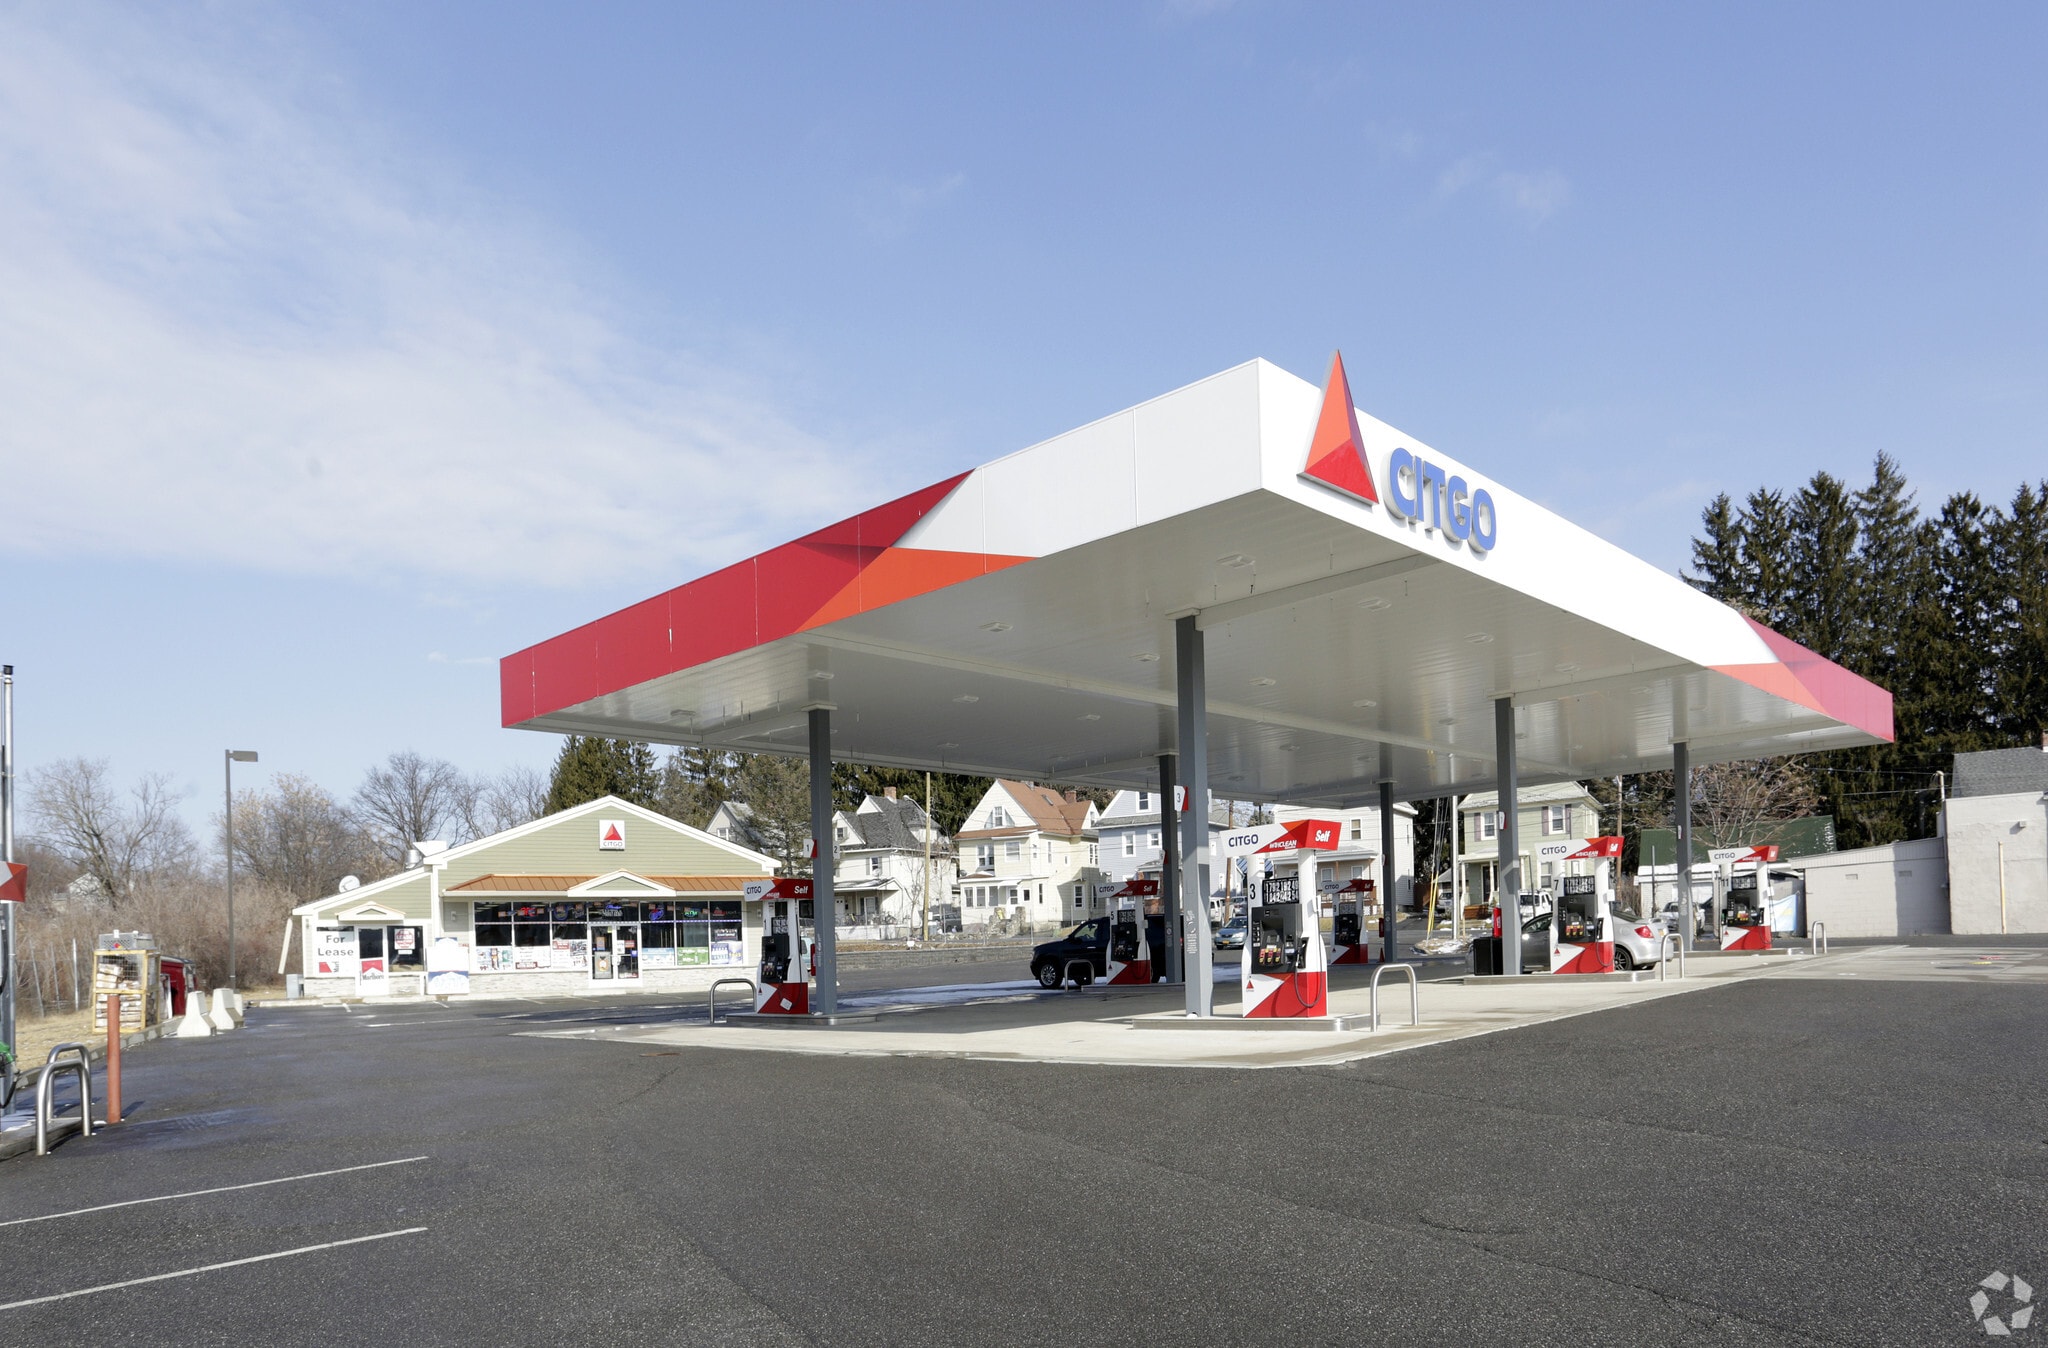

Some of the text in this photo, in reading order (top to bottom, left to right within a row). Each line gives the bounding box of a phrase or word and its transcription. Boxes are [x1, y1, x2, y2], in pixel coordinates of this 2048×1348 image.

[1389, 447, 1496, 551] CITGO
[1176, 792, 1180, 802] 3
[1228, 834, 1259, 847] CITGO
[1316, 830, 1330, 842] Self
[1542, 846, 1566, 855] CITGO
[746, 886, 762, 894] CITGO
[794, 885, 808, 894] Self
[1554, 880, 1559, 891] 7
[1250, 884, 1256, 900] 3
[1110, 911, 1114, 920] 5
[326, 935, 345, 943] For
[318, 948, 354, 956] Lease
